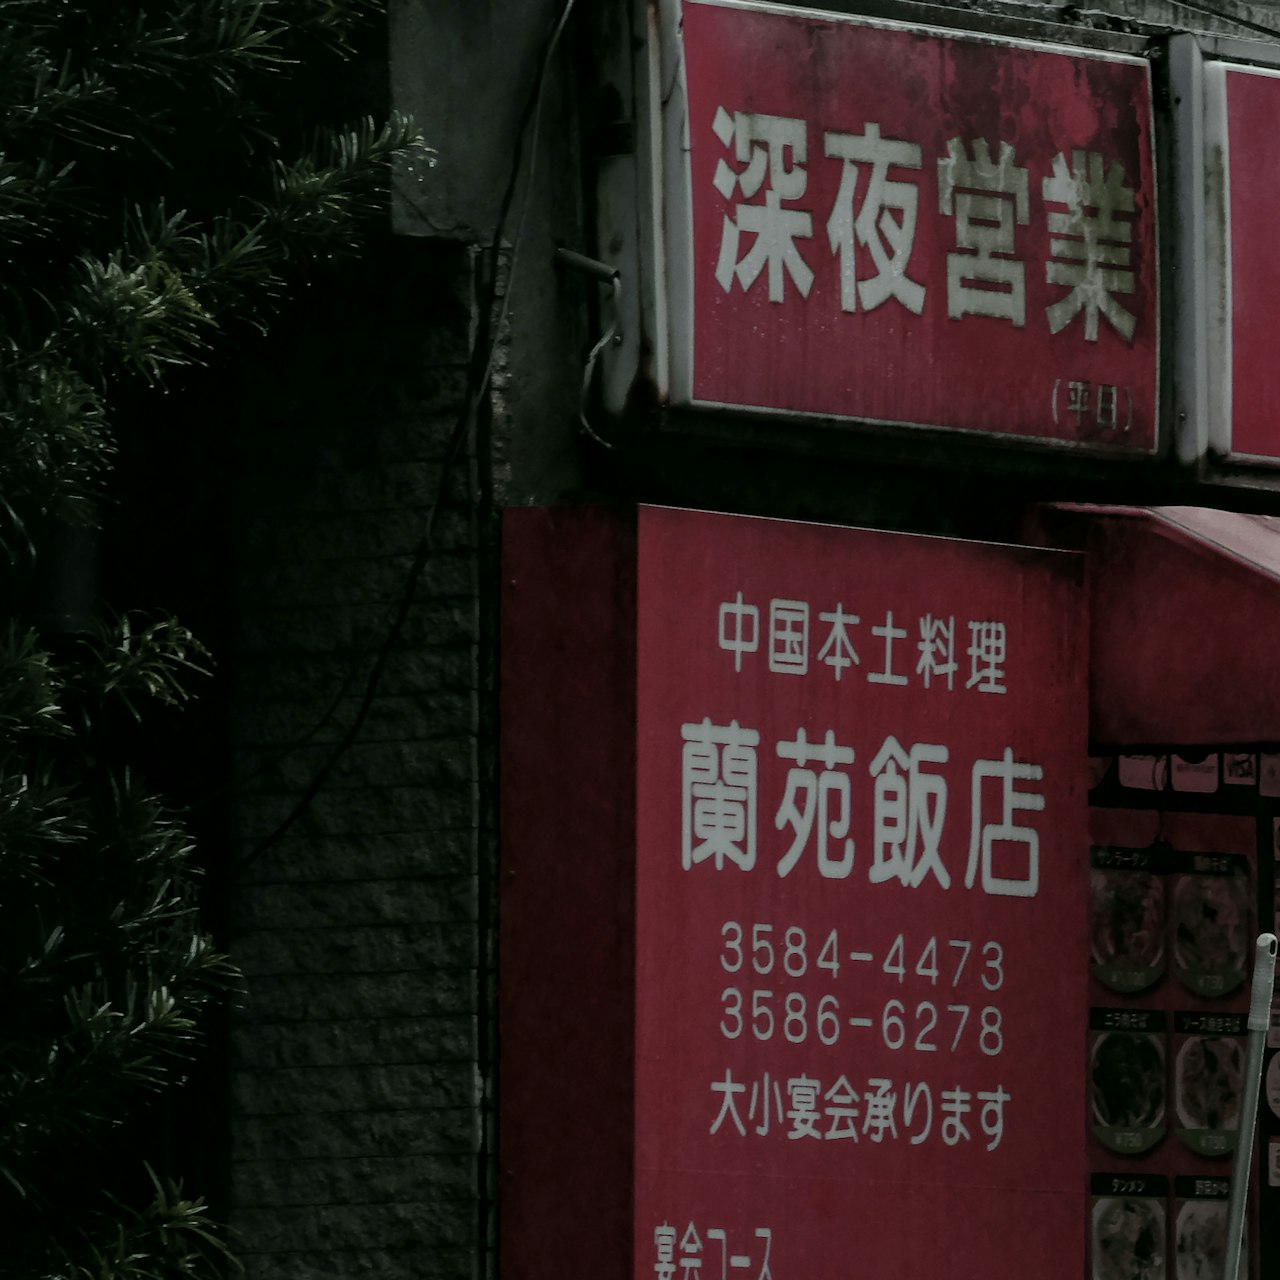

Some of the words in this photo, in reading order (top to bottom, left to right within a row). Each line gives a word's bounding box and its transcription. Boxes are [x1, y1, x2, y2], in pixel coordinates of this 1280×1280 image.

[711, 105, 1137, 344] 深夜営業
[1051, 378, 1133, 432] (平日)
[718, 590, 1008, 695] 中国本土料理
[680, 716, 1046, 898] 蘭苑飯店
[719, 920, 1005, 992] 3584-4473
[719, 987, 1004, 1056] 3586-6278
[709, 1068, 1012, 1152] 大小宴会承ります
[1111, 1178, 1147, 1195] タンメン
